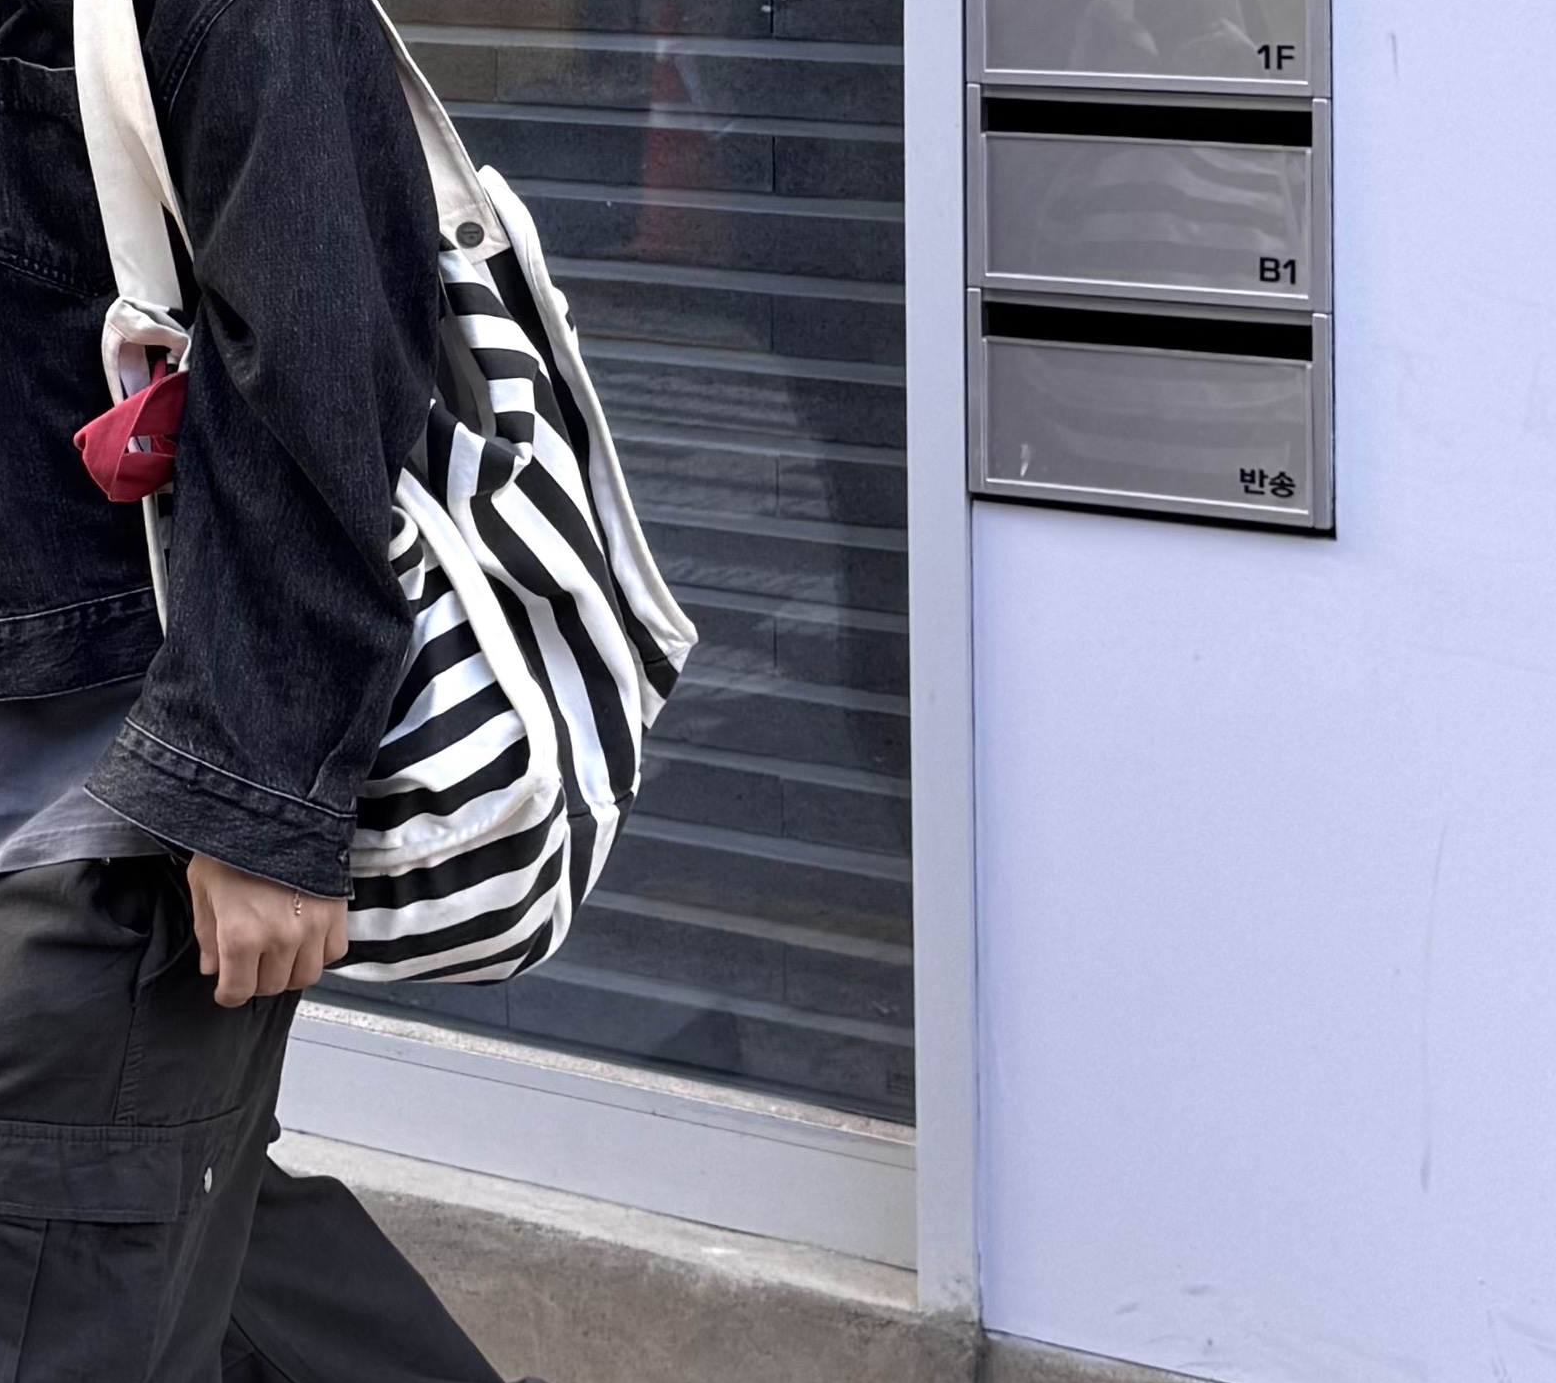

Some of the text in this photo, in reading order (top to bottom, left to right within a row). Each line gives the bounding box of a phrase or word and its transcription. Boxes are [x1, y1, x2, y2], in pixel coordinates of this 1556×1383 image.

[1257, 44, 1295, 71] 1F
[1259, 256, 1297, 285] B1
[1239, 467, 1297, 499] 반송
